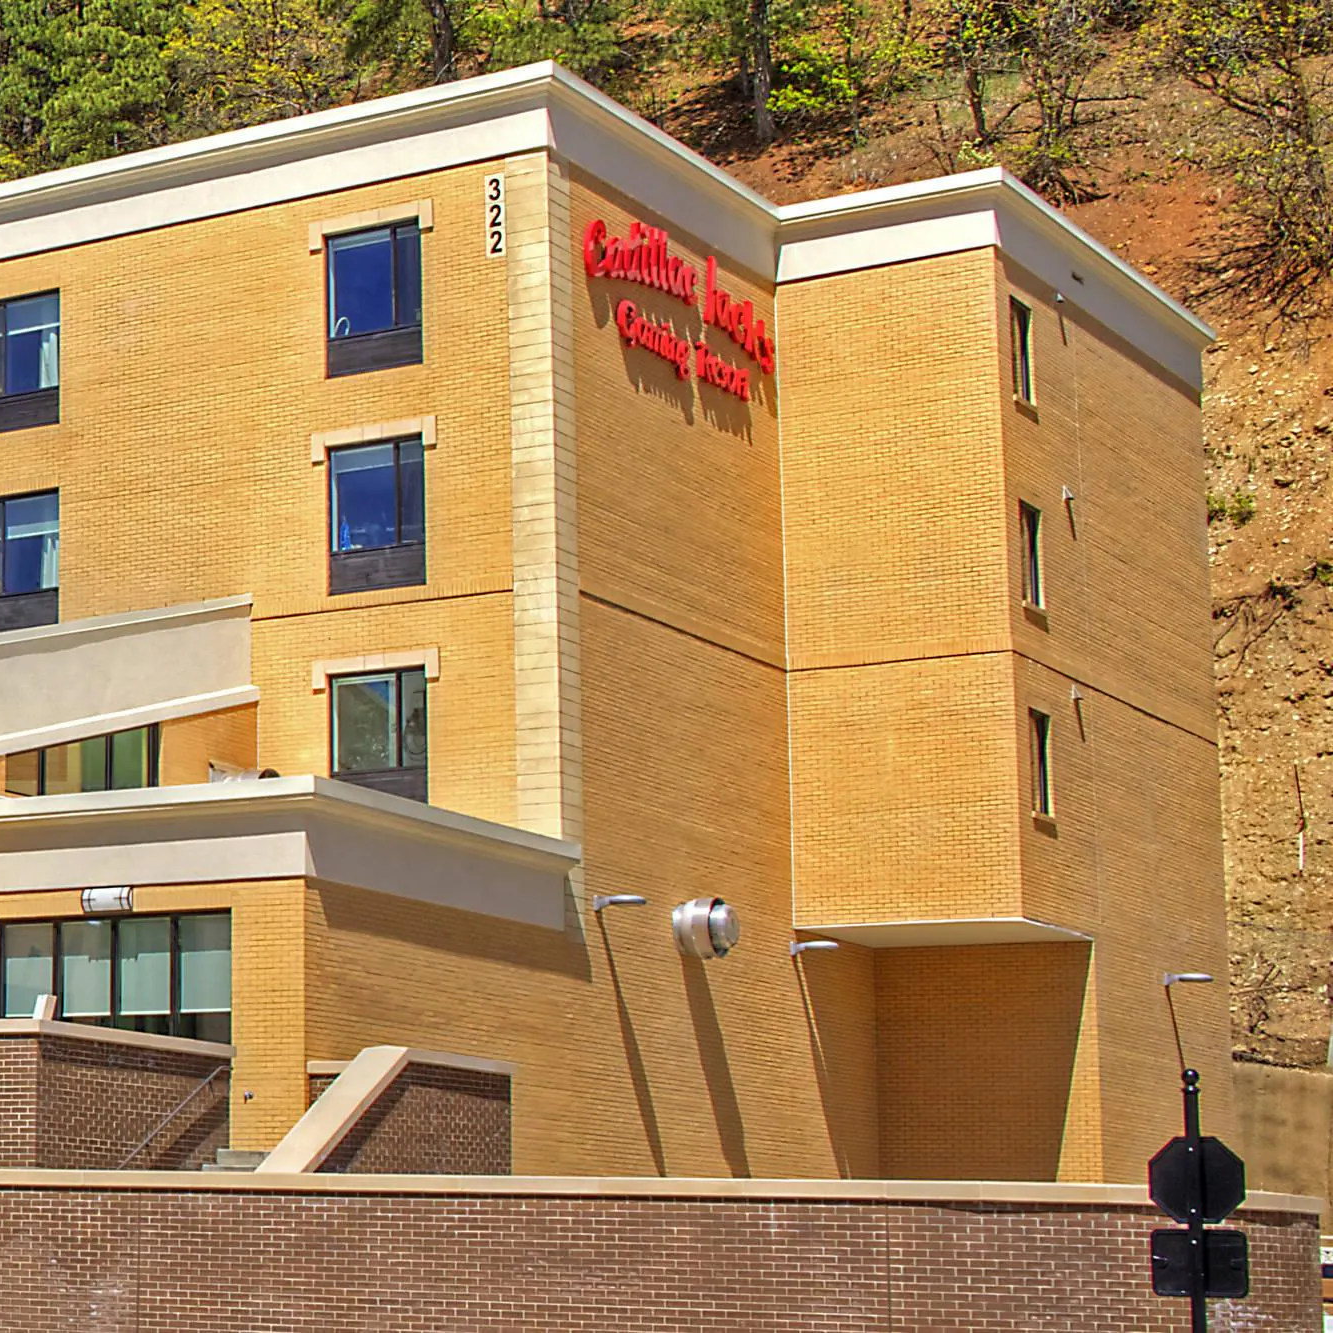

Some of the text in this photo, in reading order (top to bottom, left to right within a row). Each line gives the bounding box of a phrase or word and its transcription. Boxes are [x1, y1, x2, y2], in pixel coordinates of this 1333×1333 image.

[487, 177, 504, 255] 322
[583, 219, 775, 375] Cadillac Jack's
[616, 299, 691, 382] Gaming
